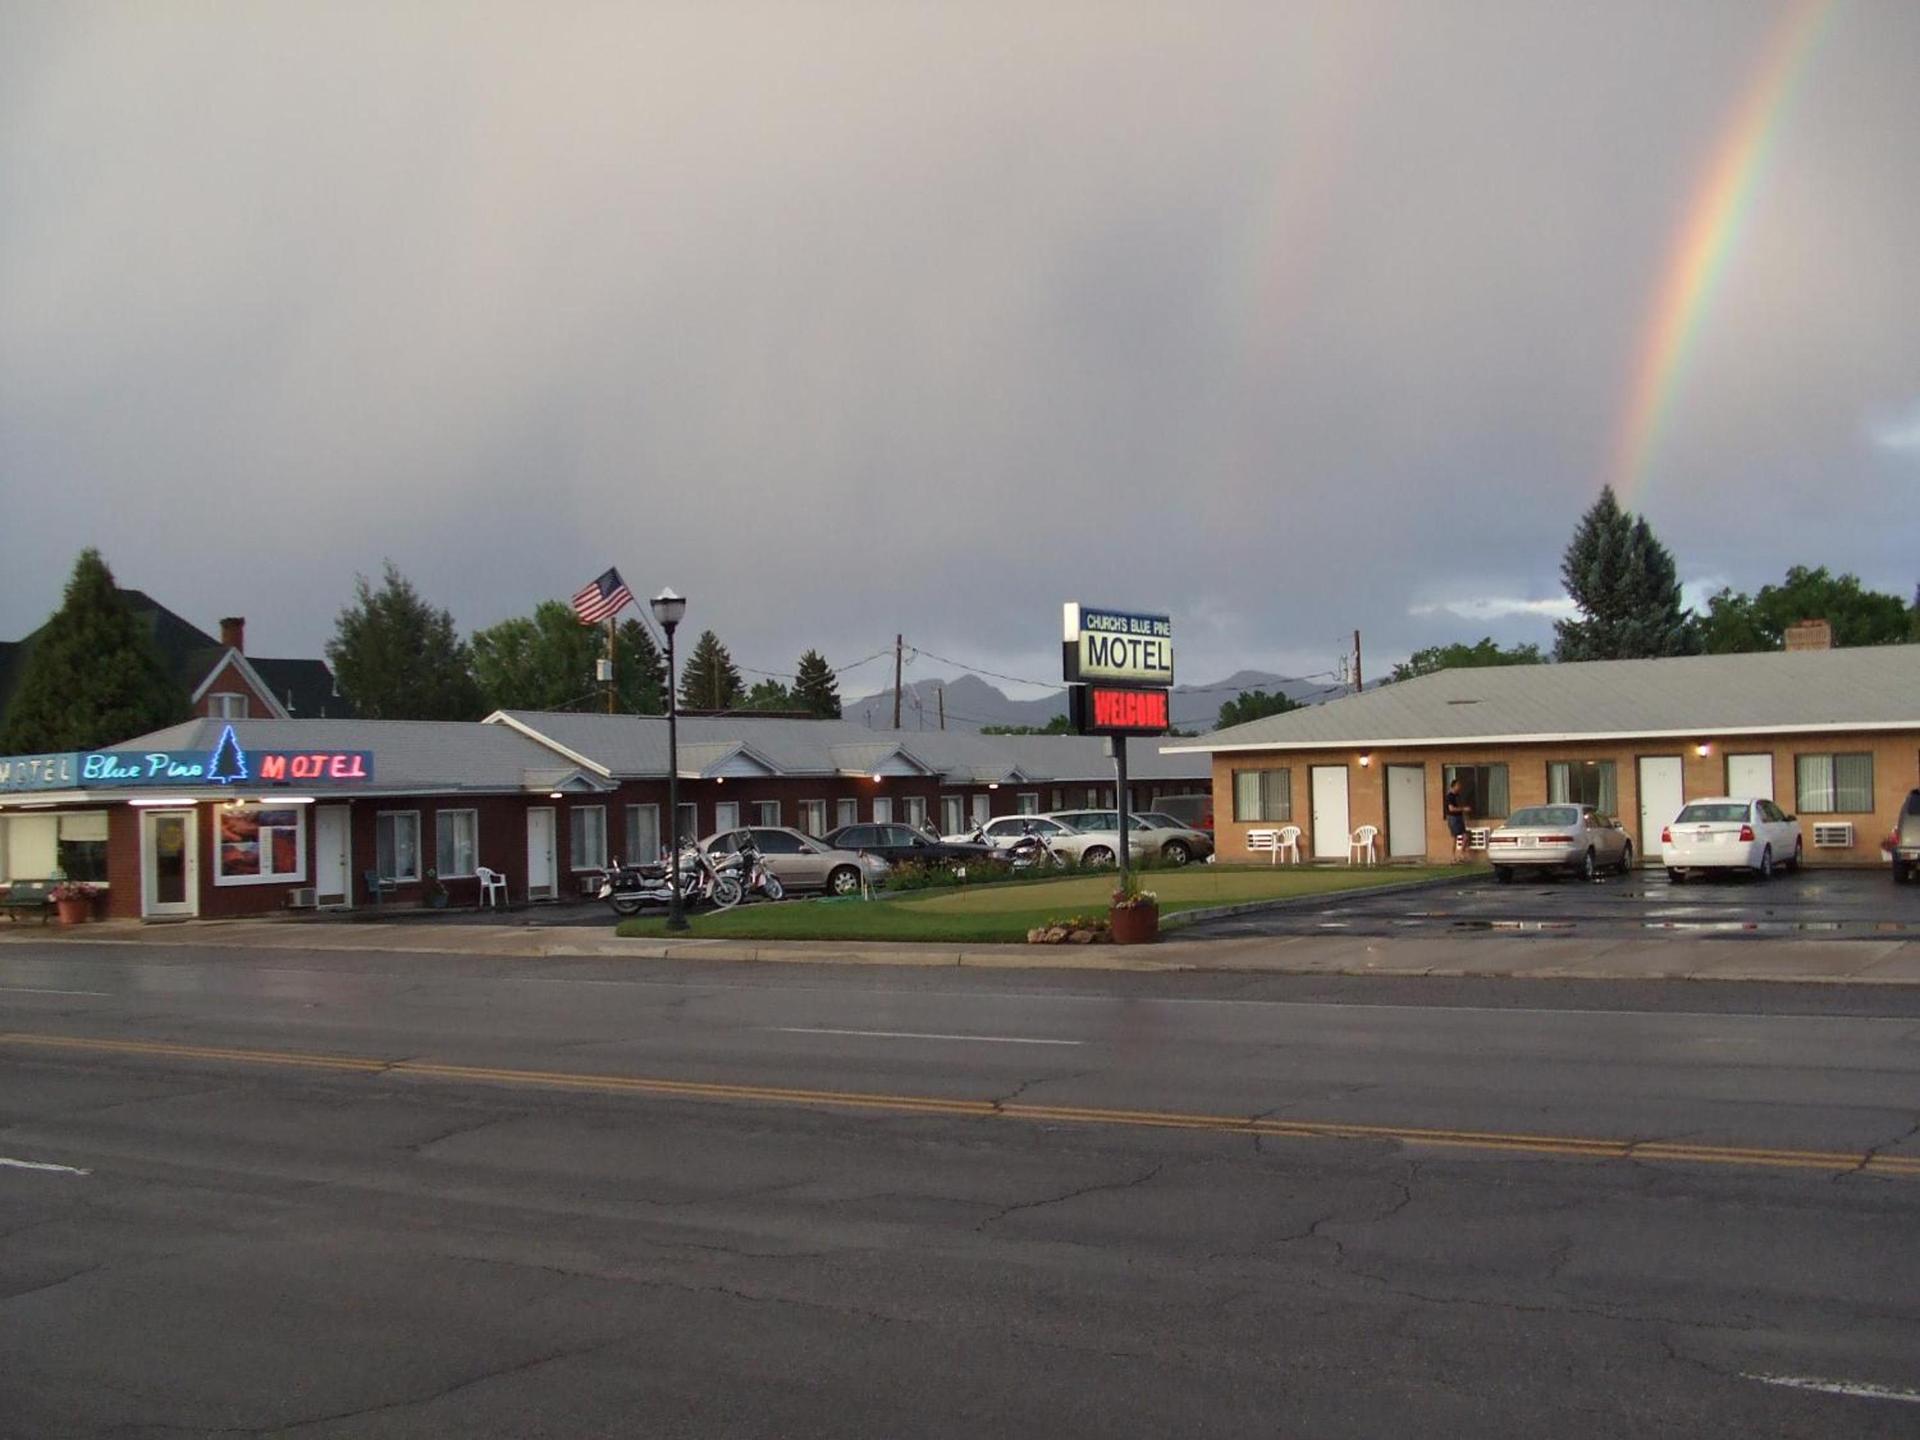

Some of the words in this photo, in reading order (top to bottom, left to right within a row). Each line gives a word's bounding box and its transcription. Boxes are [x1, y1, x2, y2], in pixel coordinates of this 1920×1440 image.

[1087, 614, 1128, 632] CHURCH'S
[1131, 619, 1151, 634] BLUE
[1154, 622, 1170, 636] PINE
[1089, 636, 1170, 670] MOTEL
[1094, 691, 1167, 727] WELCOME
[83, 754, 141, 778] Blue
[145, 753, 203, 777] Pine
[260, 755, 366, 778] MOTEL
